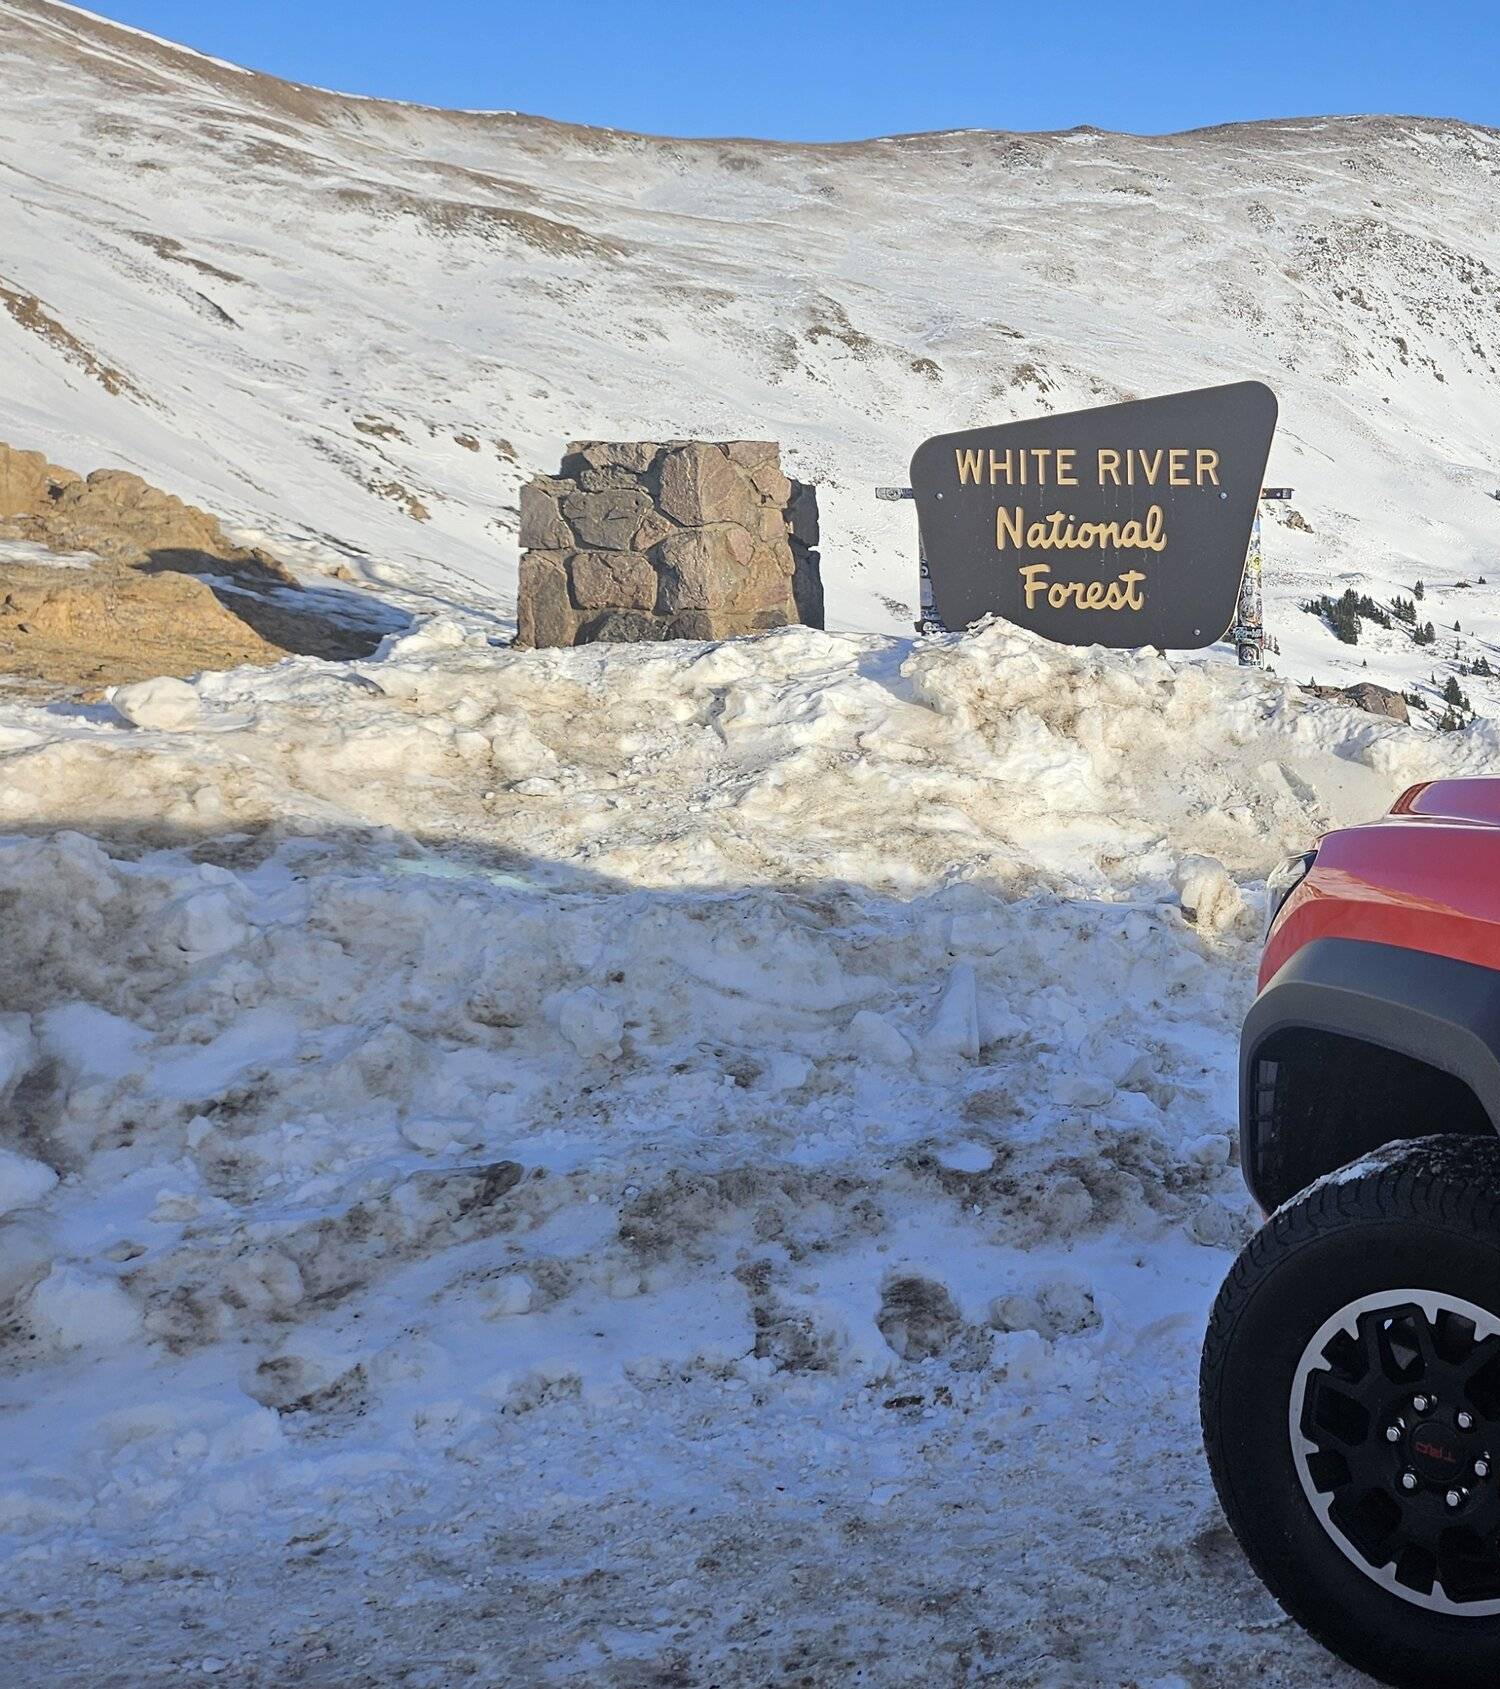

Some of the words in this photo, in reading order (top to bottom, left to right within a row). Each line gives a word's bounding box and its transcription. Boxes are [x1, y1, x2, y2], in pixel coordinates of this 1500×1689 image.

[955, 448, 1079, 486] WHITE
[1098, 448, 1220, 486] RIVER
[996, 505, 1167, 552] National
[1019, 563, 1147, 611] Forest
